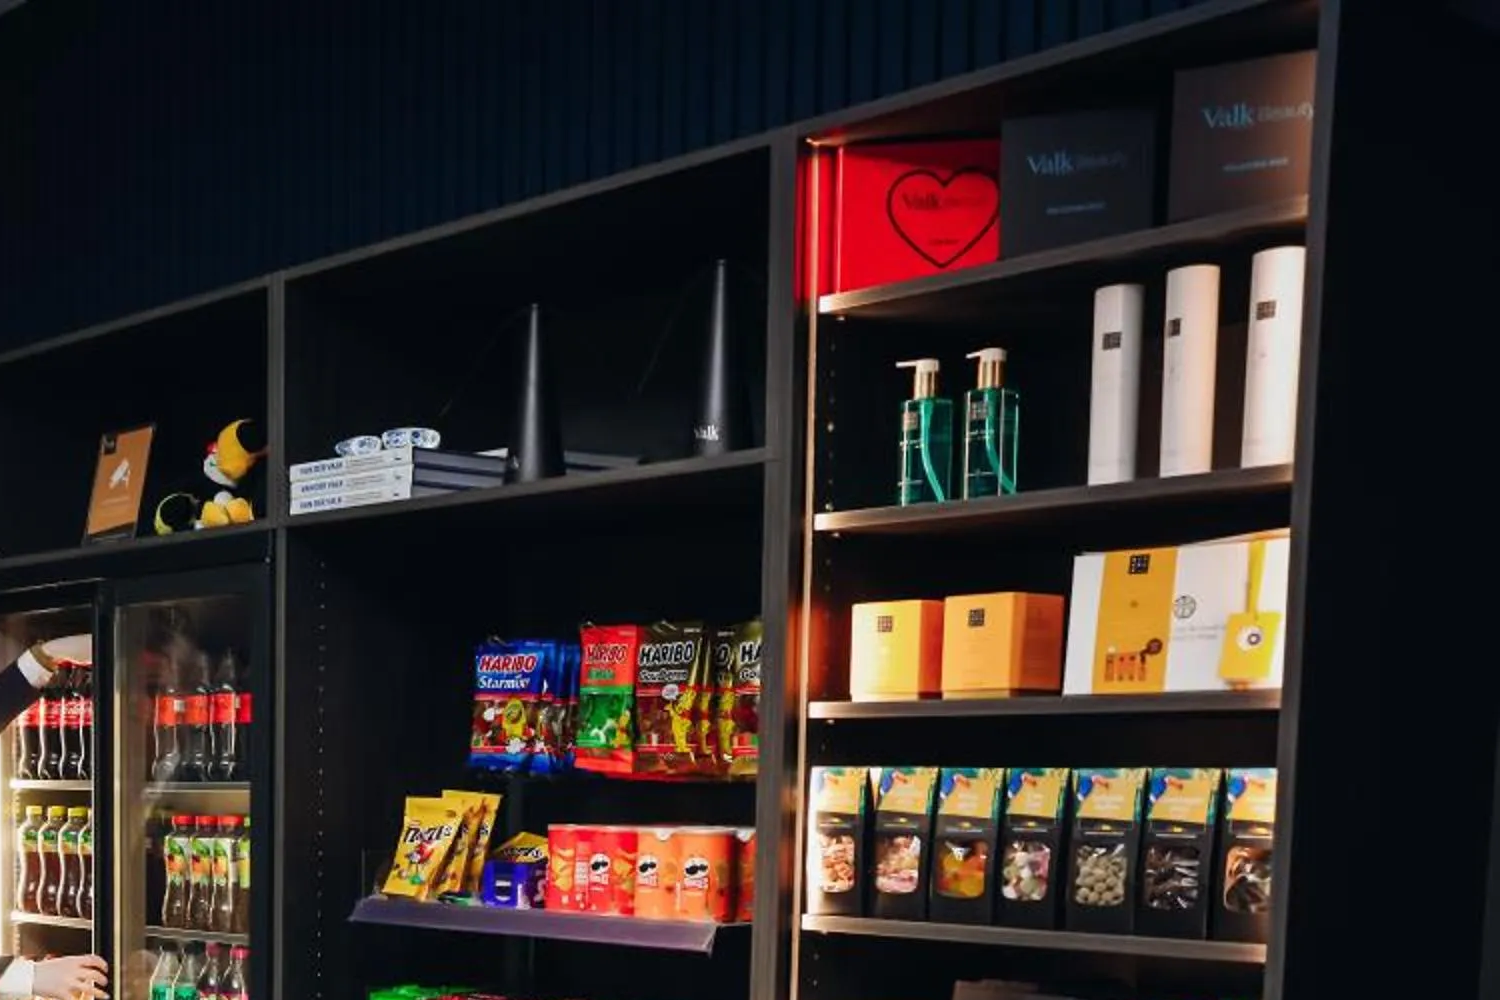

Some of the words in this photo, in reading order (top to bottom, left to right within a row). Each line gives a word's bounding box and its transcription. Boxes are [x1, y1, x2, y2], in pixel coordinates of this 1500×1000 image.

[1201, 102, 1255, 129] Valk
[1026, 149, 1074, 176] Valk
[478, 653, 538, 673] HARIBO
[638, 640, 695, 665] HARIBO
